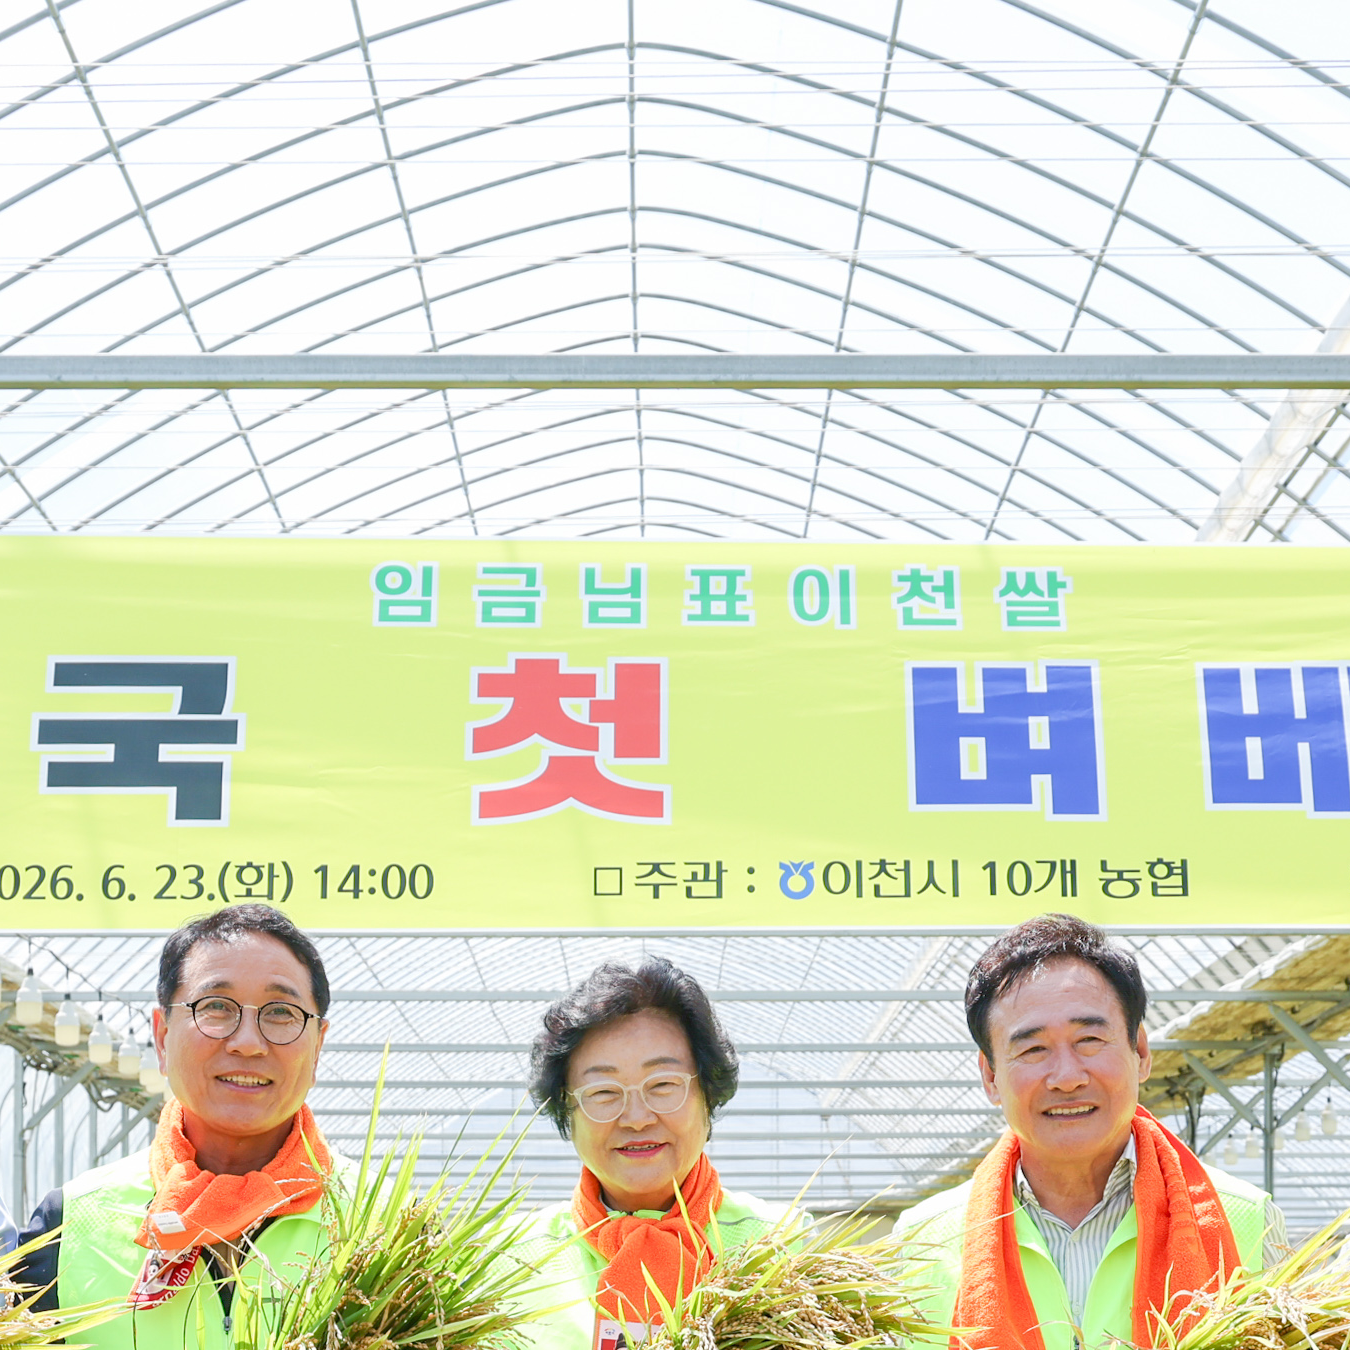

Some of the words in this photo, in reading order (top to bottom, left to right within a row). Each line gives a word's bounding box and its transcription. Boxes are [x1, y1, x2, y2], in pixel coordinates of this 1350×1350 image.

[375, 564, 1069, 628] 임금님표이천쌀
[472, 657, 665, 820] 첫
[101, 863, 135, 902] 6.
[153, 861, 294, 904] 23.(화)
[314, 863, 435, 901] 14:00
[633, 861, 728, 899] 주관
[822, 859, 960, 898] 이천시
[982, 859, 1078, 897] 10개
[1098, 857, 1190, 899] 농협
